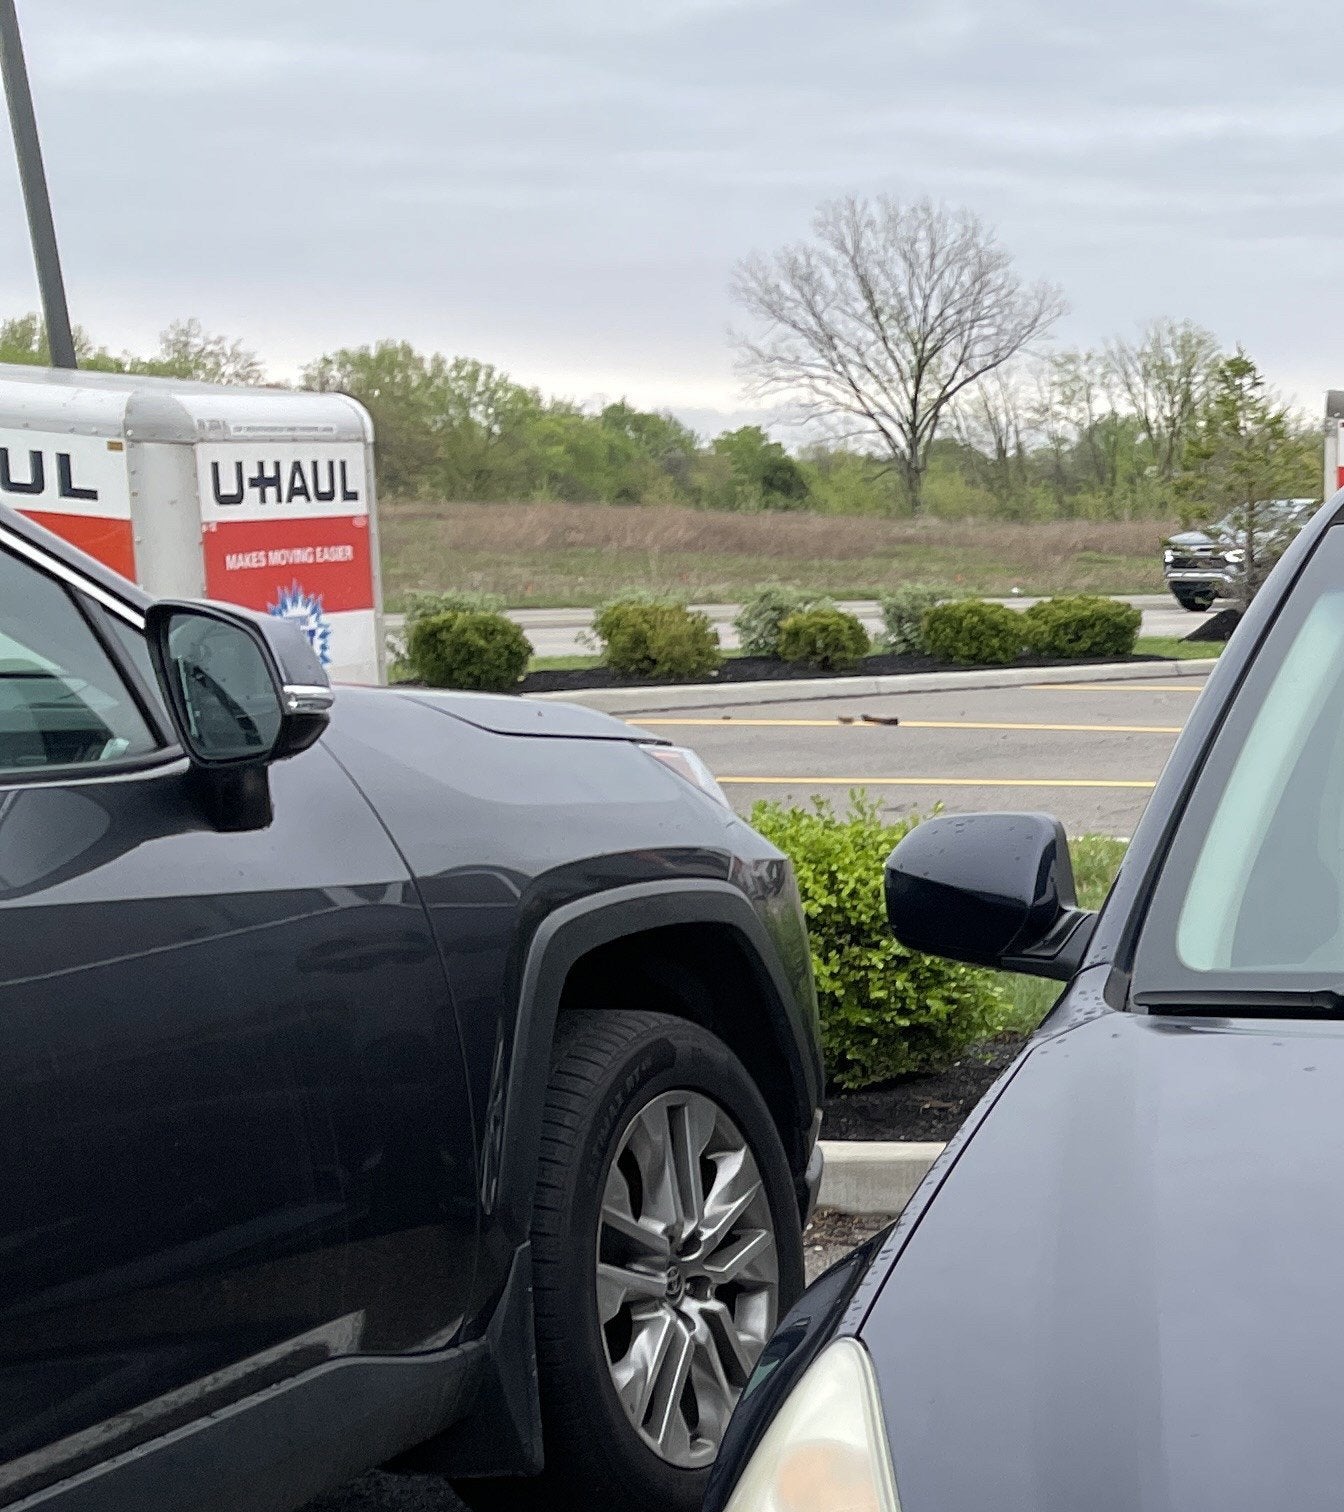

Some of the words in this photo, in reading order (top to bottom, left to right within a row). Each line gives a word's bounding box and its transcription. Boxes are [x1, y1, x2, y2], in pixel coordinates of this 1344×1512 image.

[210, 460, 359, 505] U-HAUL
[225, 550, 266, 571] MAKES
[267, 547, 314, 567] MOVING
